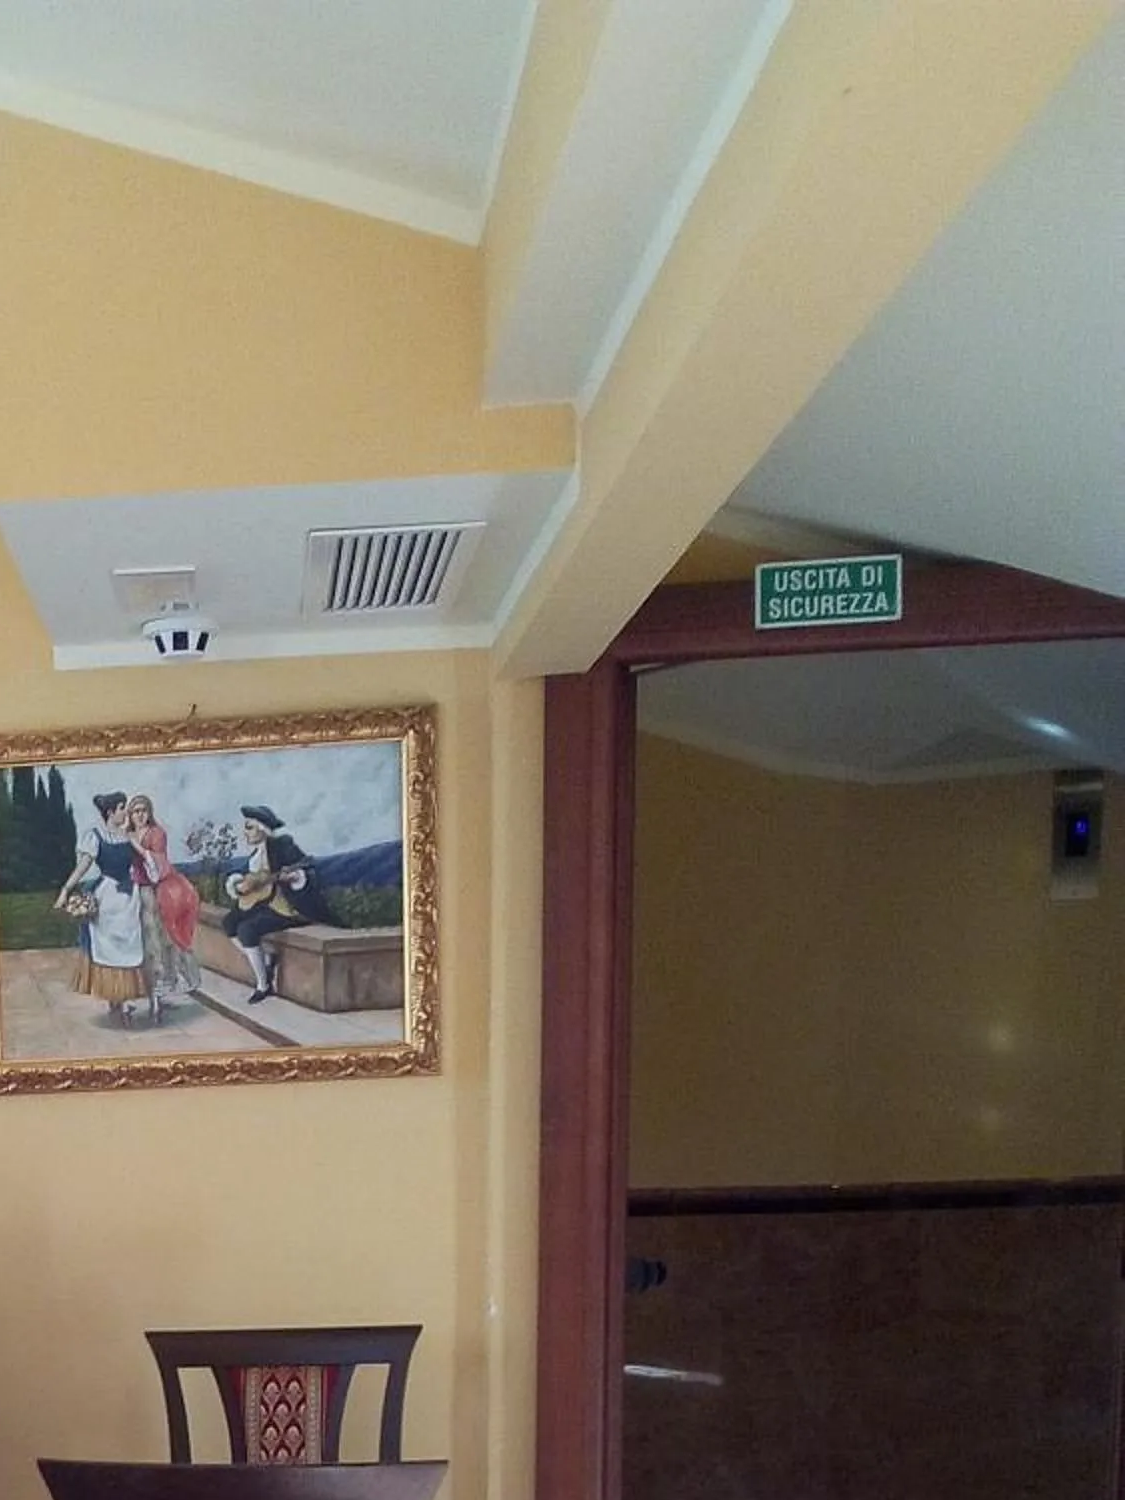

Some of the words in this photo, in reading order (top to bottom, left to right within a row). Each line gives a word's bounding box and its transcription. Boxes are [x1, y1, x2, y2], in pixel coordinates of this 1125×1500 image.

[774, 566, 850, 592] USCITA
[862, 565, 883, 587] DI
[768, 592, 888, 618] SICUREZZA
